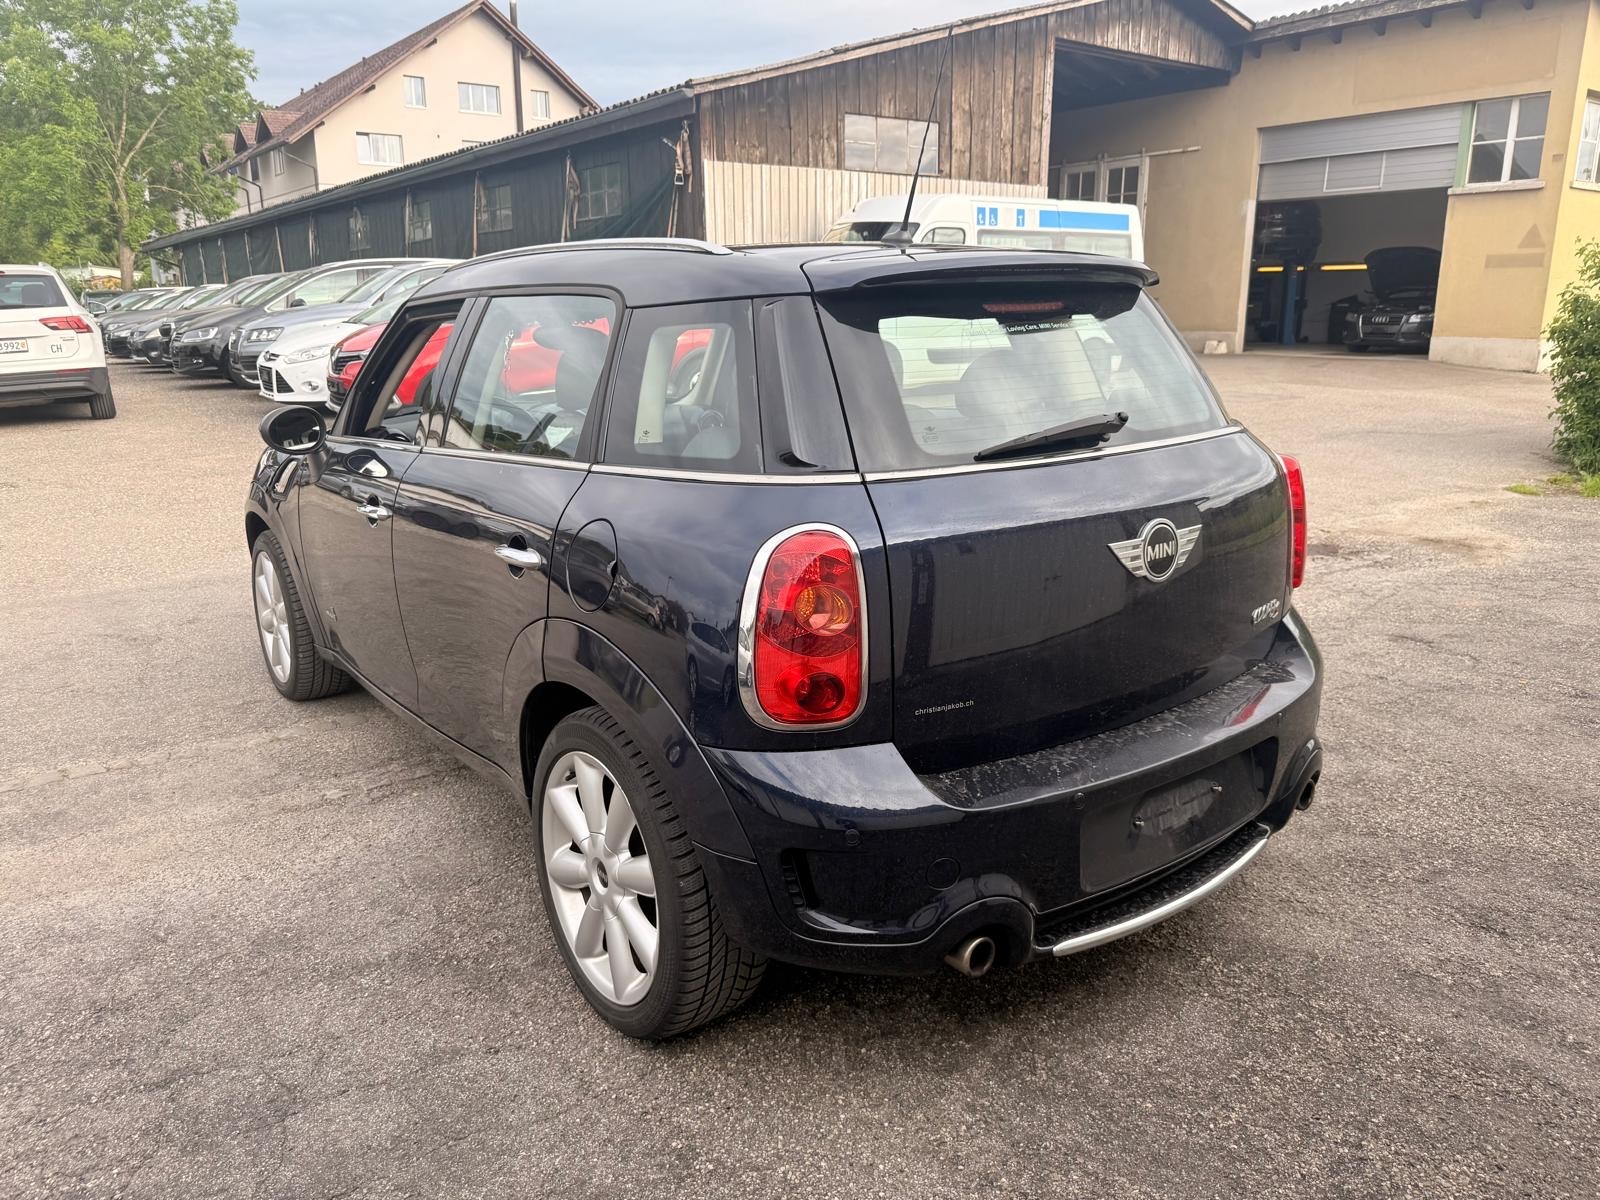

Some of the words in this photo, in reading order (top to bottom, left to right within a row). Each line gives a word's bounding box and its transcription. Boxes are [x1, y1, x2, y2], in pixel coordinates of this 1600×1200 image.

[1006, 325, 1027, 333] Loving
[50, 343, 63, 353] CH
[1147, 540, 1175, 562] MINI
[914, 699, 975, 716] christianjakob.ch
